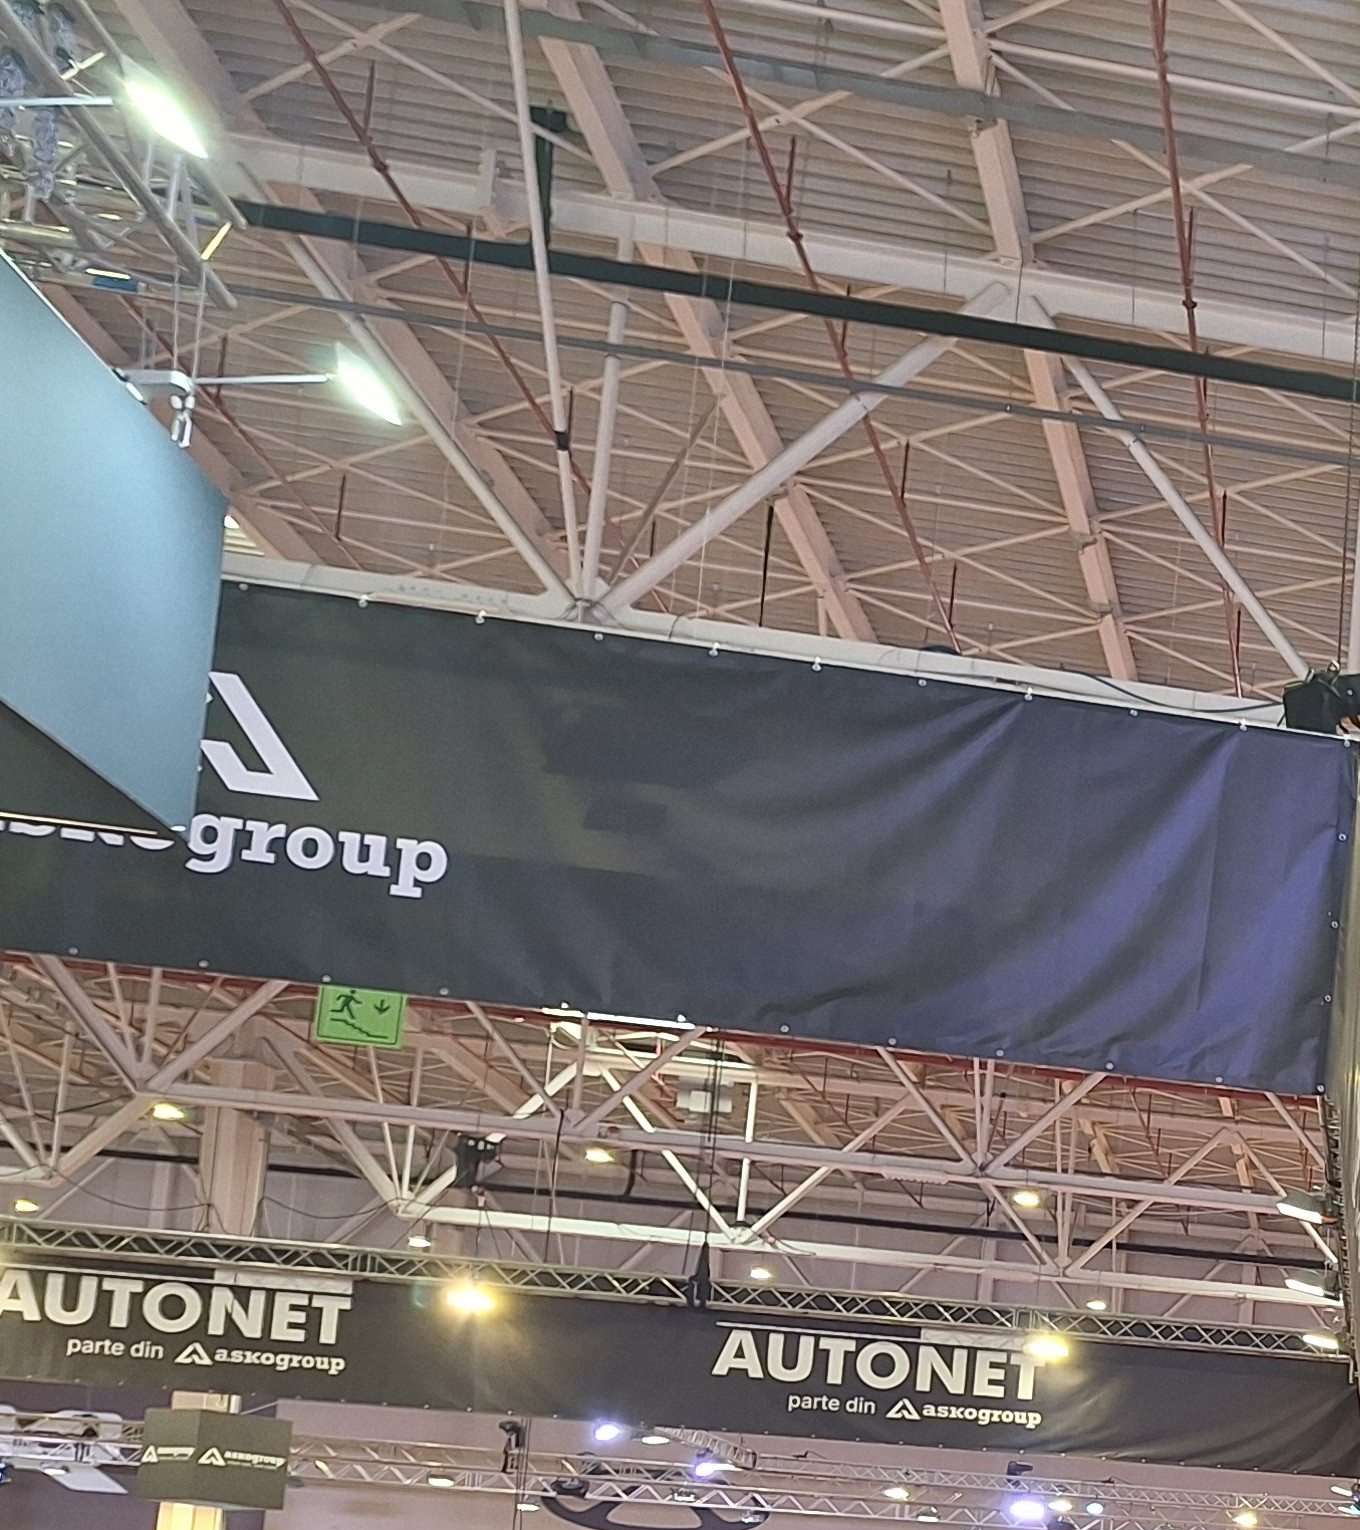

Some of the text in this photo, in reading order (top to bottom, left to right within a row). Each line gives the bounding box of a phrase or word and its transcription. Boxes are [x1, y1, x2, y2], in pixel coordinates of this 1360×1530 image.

[0, 1268, 352, 1344] AUTONET
[66, 1338, 346, 1375] parte din askogroup
[711, 1329, 1046, 1400] AUTONET
[788, 1394, 1042, 1430] parte din askogroup
